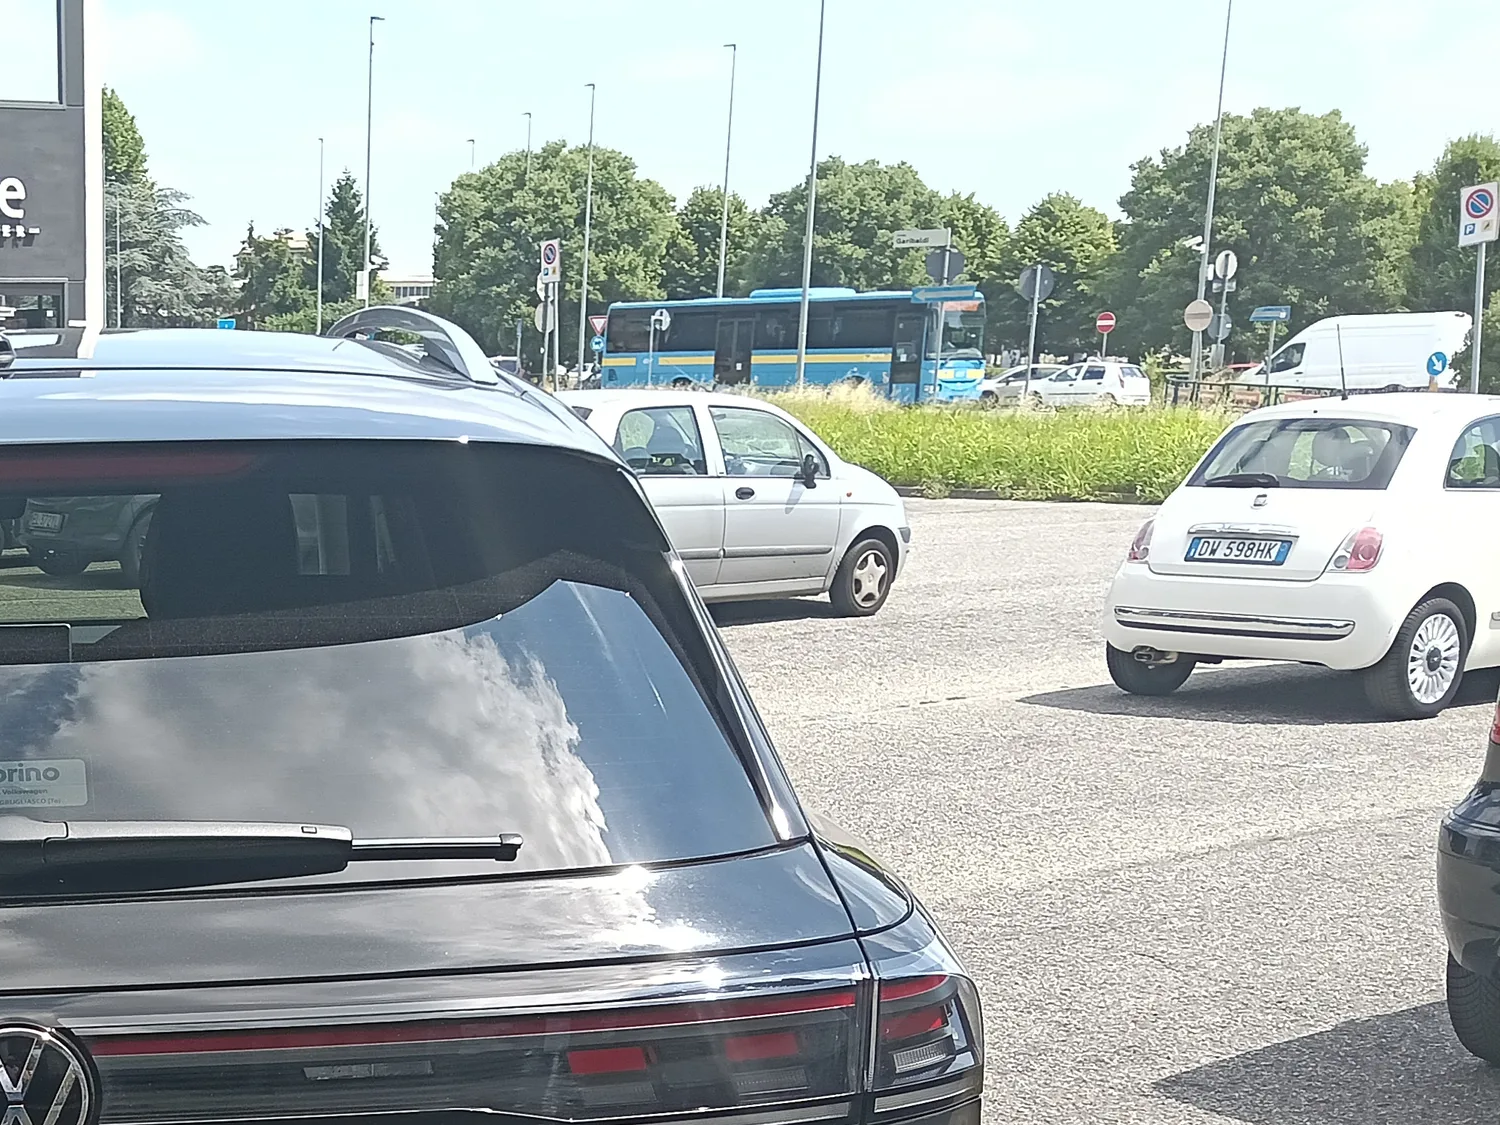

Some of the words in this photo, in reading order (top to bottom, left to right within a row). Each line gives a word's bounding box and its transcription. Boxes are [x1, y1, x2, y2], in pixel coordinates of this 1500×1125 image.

[1198, 540, 1221, 556] DW
[1223, 541, 1278, 559] 598HK
[2, 788, 48, 796] Volkswagen
